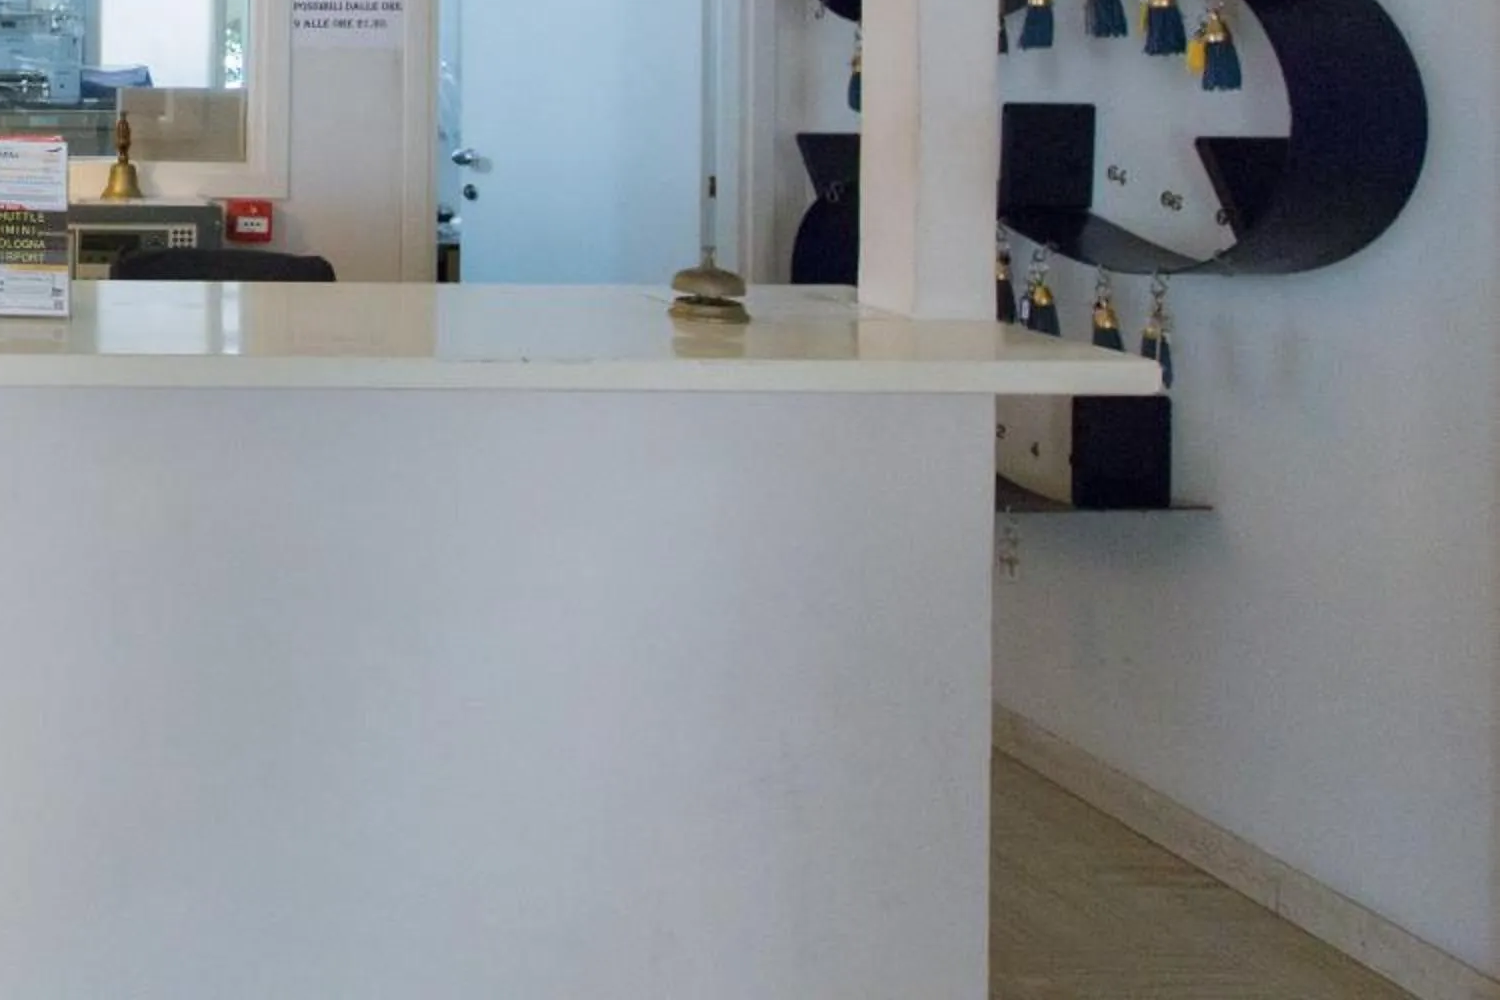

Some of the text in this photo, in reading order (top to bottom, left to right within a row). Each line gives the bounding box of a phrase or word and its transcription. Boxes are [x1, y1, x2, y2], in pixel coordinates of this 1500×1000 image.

[293, 1, 343, 11] POSSIBILI
[345, 1, 379, 11] DALLE
[303, 19, 329, 29] ALLE
